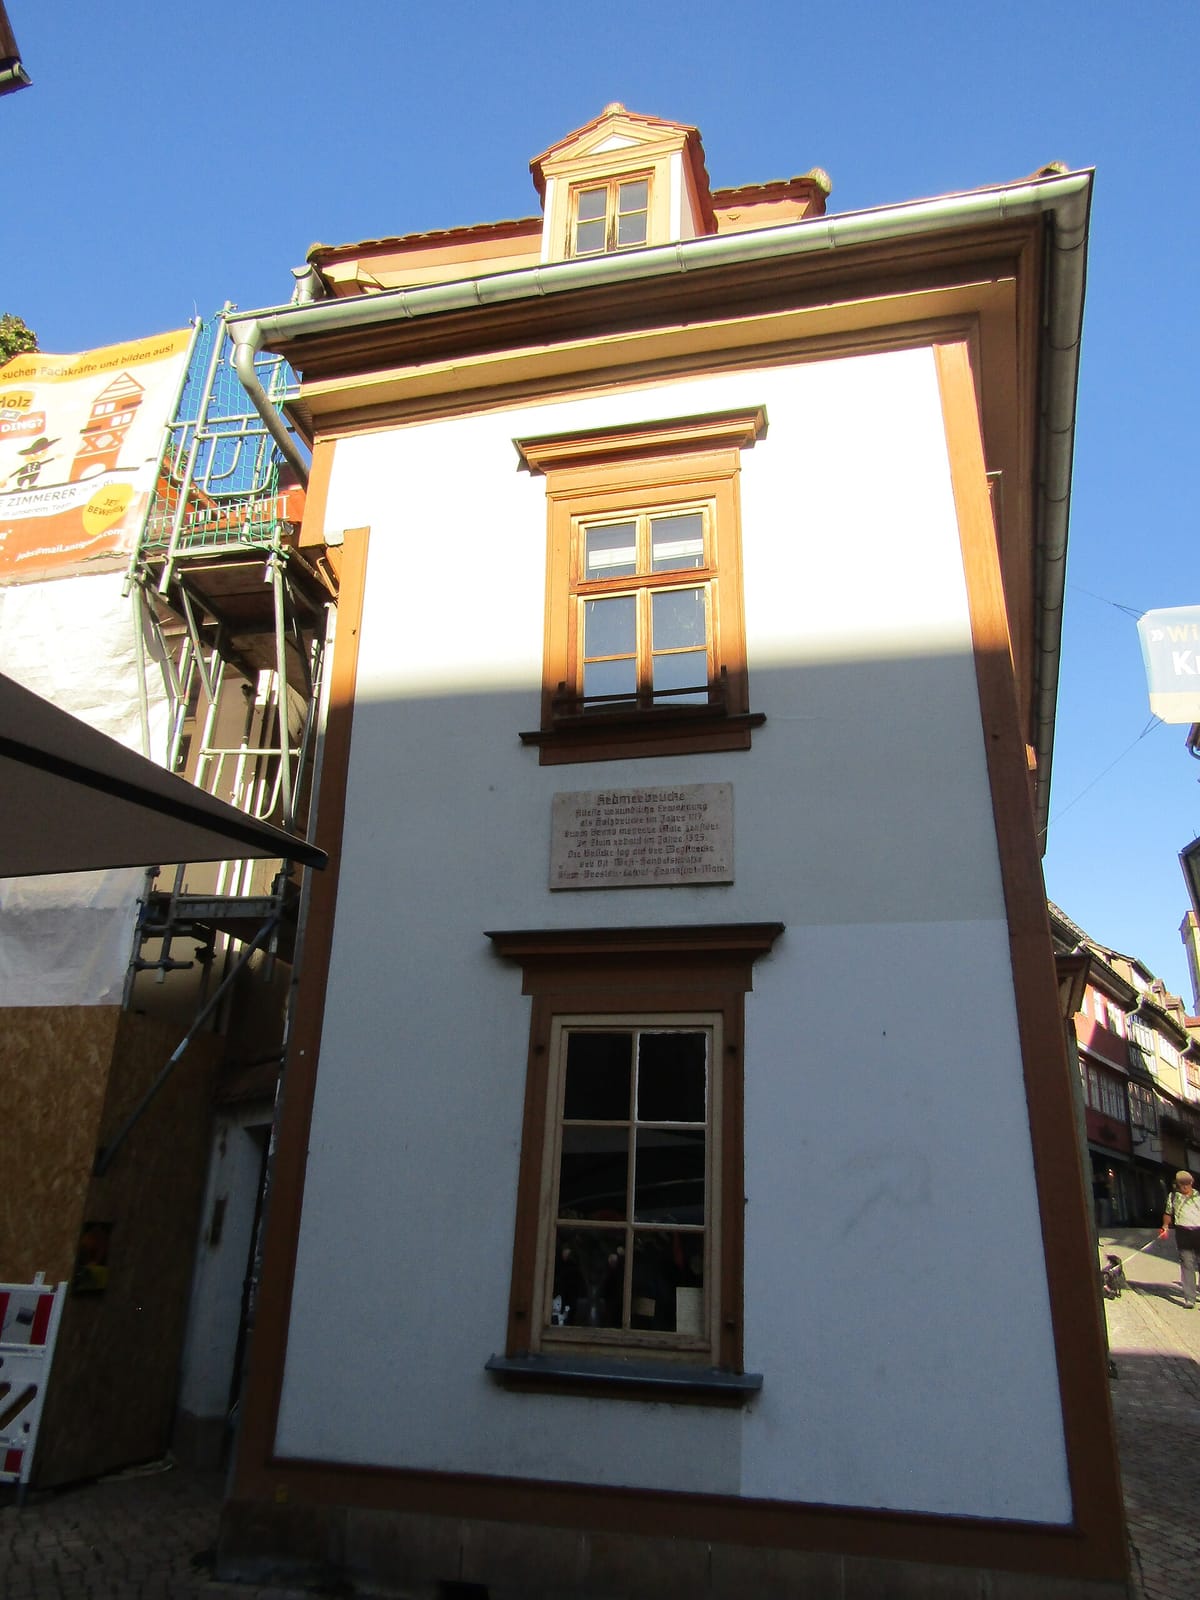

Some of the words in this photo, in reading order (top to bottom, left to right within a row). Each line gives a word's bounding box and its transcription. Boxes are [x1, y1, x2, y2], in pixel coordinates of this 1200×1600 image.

[2, 367, 36, 380] suchen
[99, 358, 119, 369] und
[120, 351, 151, 365] bilden
[152, 343, 174, 356] aus!
